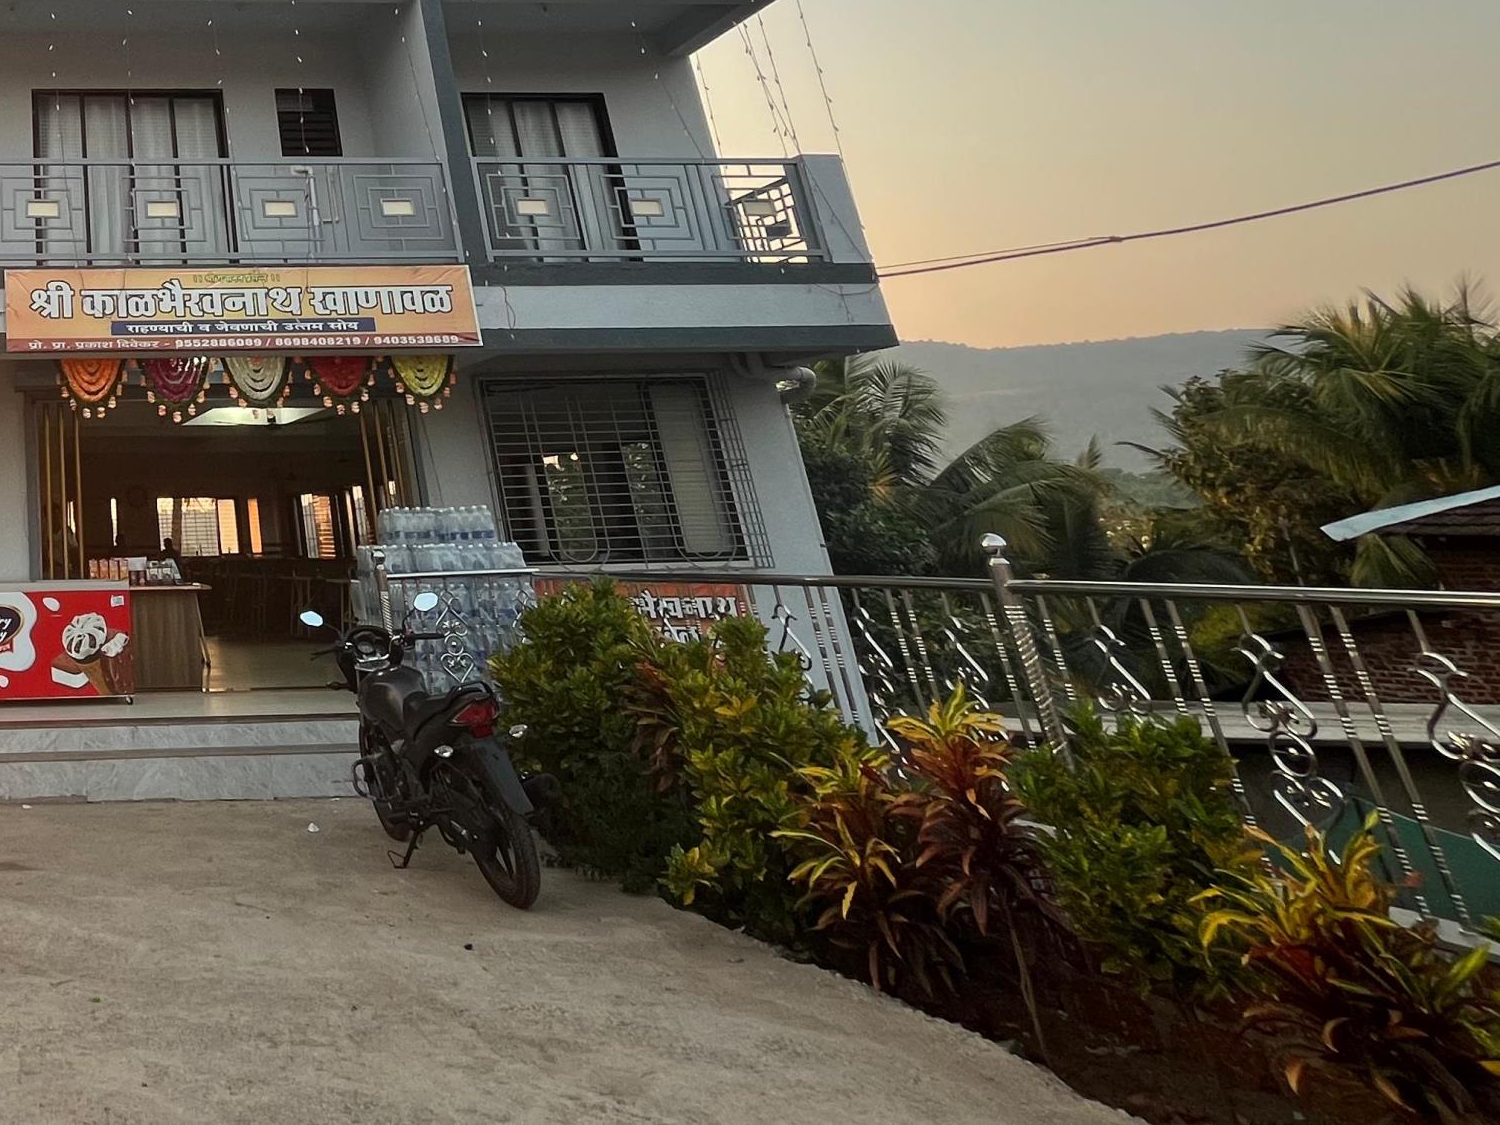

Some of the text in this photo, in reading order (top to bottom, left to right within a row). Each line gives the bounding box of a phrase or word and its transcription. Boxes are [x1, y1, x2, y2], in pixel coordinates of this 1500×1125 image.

[30, 278, 453, 318] श्री काळभैरवनाथ खाणावळ
[126, 319, 359, 334] राहण्याची व जेवणाची उत्तम सोय
[28, 339, 47, 350] प्रो.
[52, 340, 71, 350] प्रा.
[75, 340, 112, 350] प्रकाश
[117, 338, 160, 349] दिवेकर
